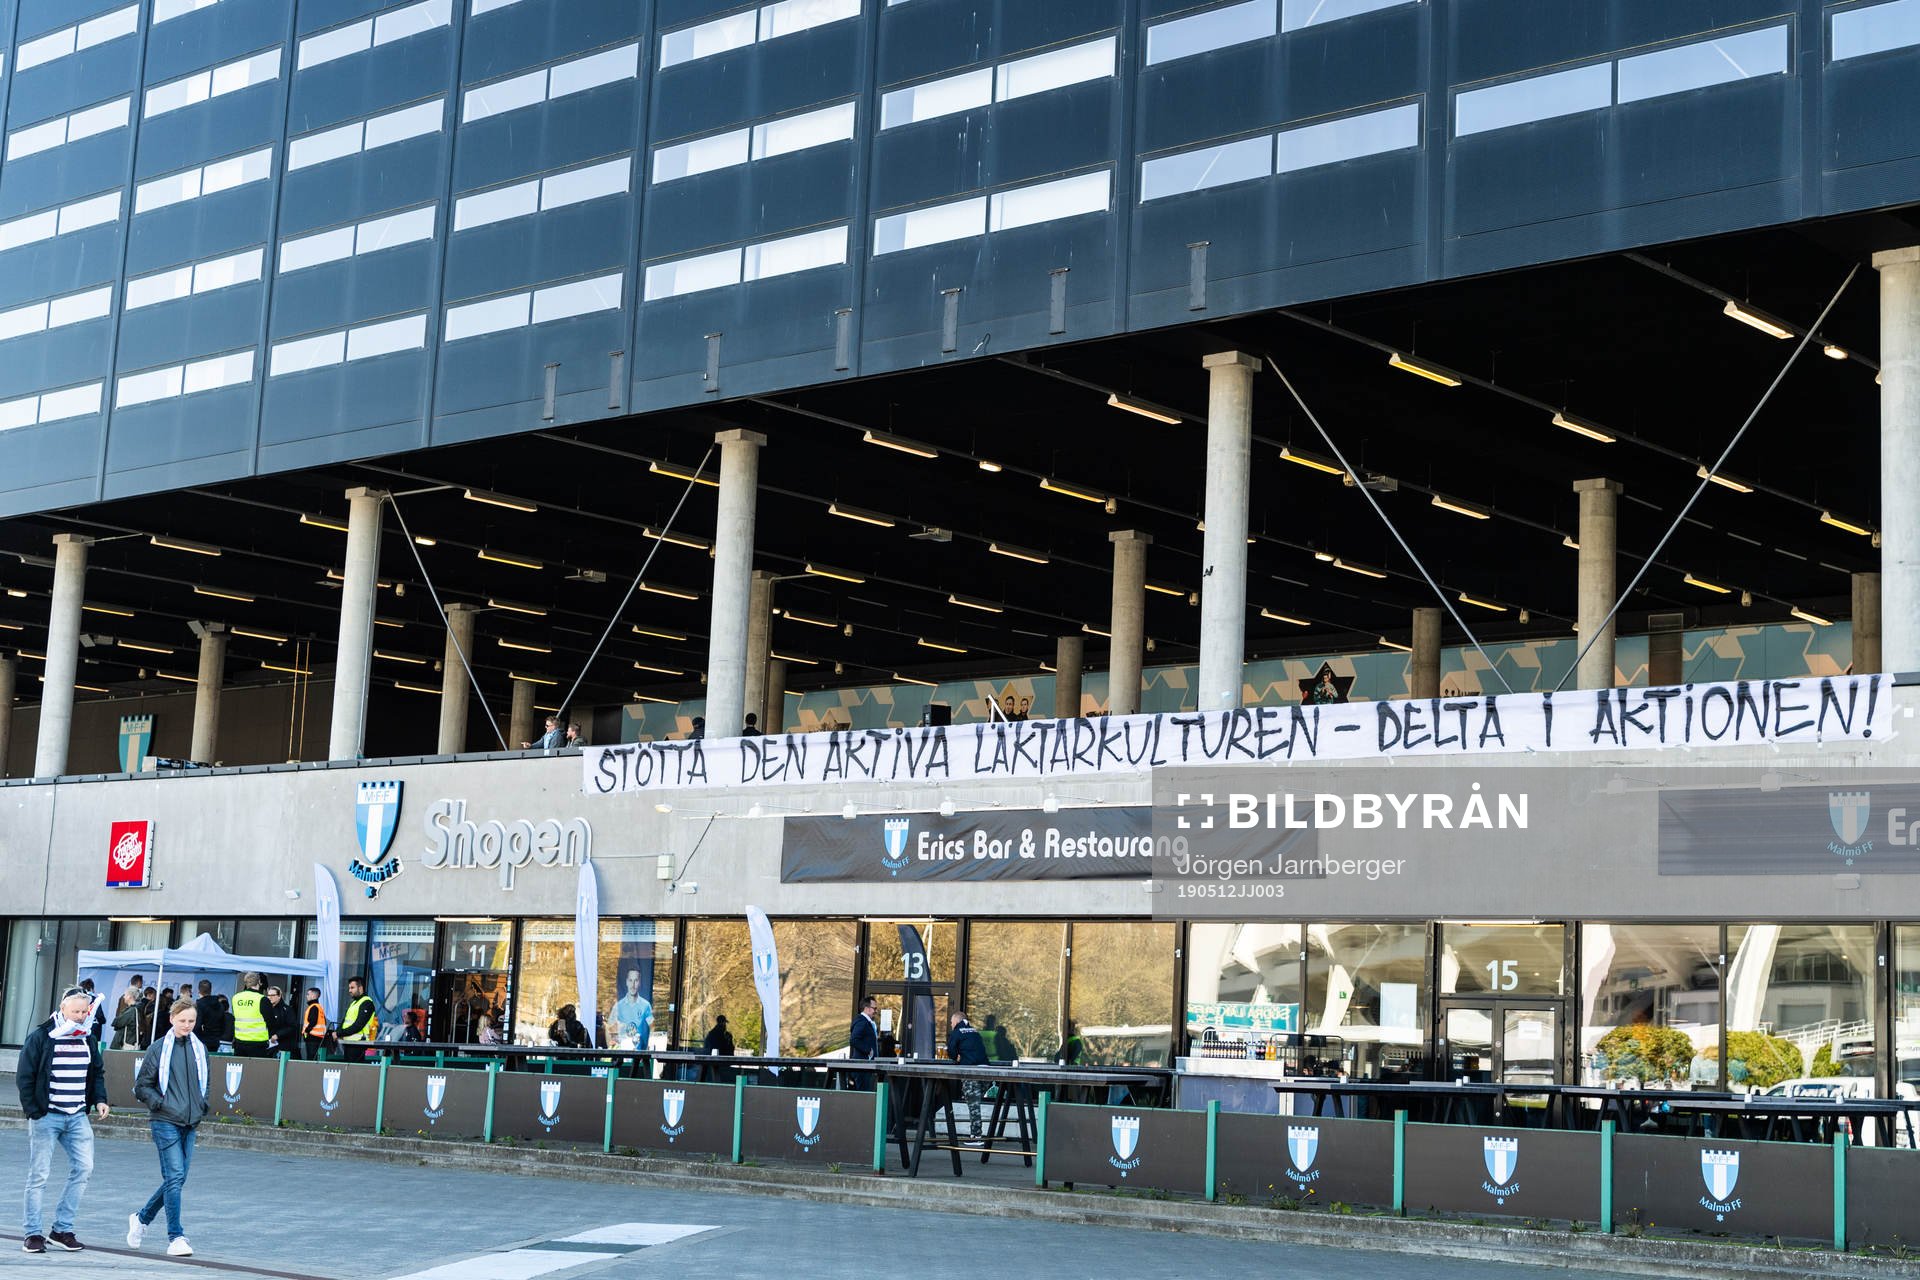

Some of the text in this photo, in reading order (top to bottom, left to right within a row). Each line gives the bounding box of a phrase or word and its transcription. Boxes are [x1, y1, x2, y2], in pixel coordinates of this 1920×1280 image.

[594, 739, 707, 793] STÖTTA
[740, 734, 807, 783] DEN
[975, 705, 1319, 775] LÄKTARKULTUREN
[1376, 696, 1505, 752] DELTA
[420, 798, 593, 891] Shopen
[917, 828, 1189, 867] Erics Bar & Restaurang
[1826, 840, 1875, 857] Malmö FF
[349, 857, 400, 882] Malmö FF
[470, 944, 486, 967] 11
[901, 952, 924, 979] 13
[1486, 959, 1519, 992] 15
[1108, 1155, 1141, 1170] Malmö FF
[1285, 1167, 1321, 1182] Malmö FF
[1481, 1180, 1521, 1196] Malmö FF
[1699, 1196, 1742, 1213] Malmö FF
